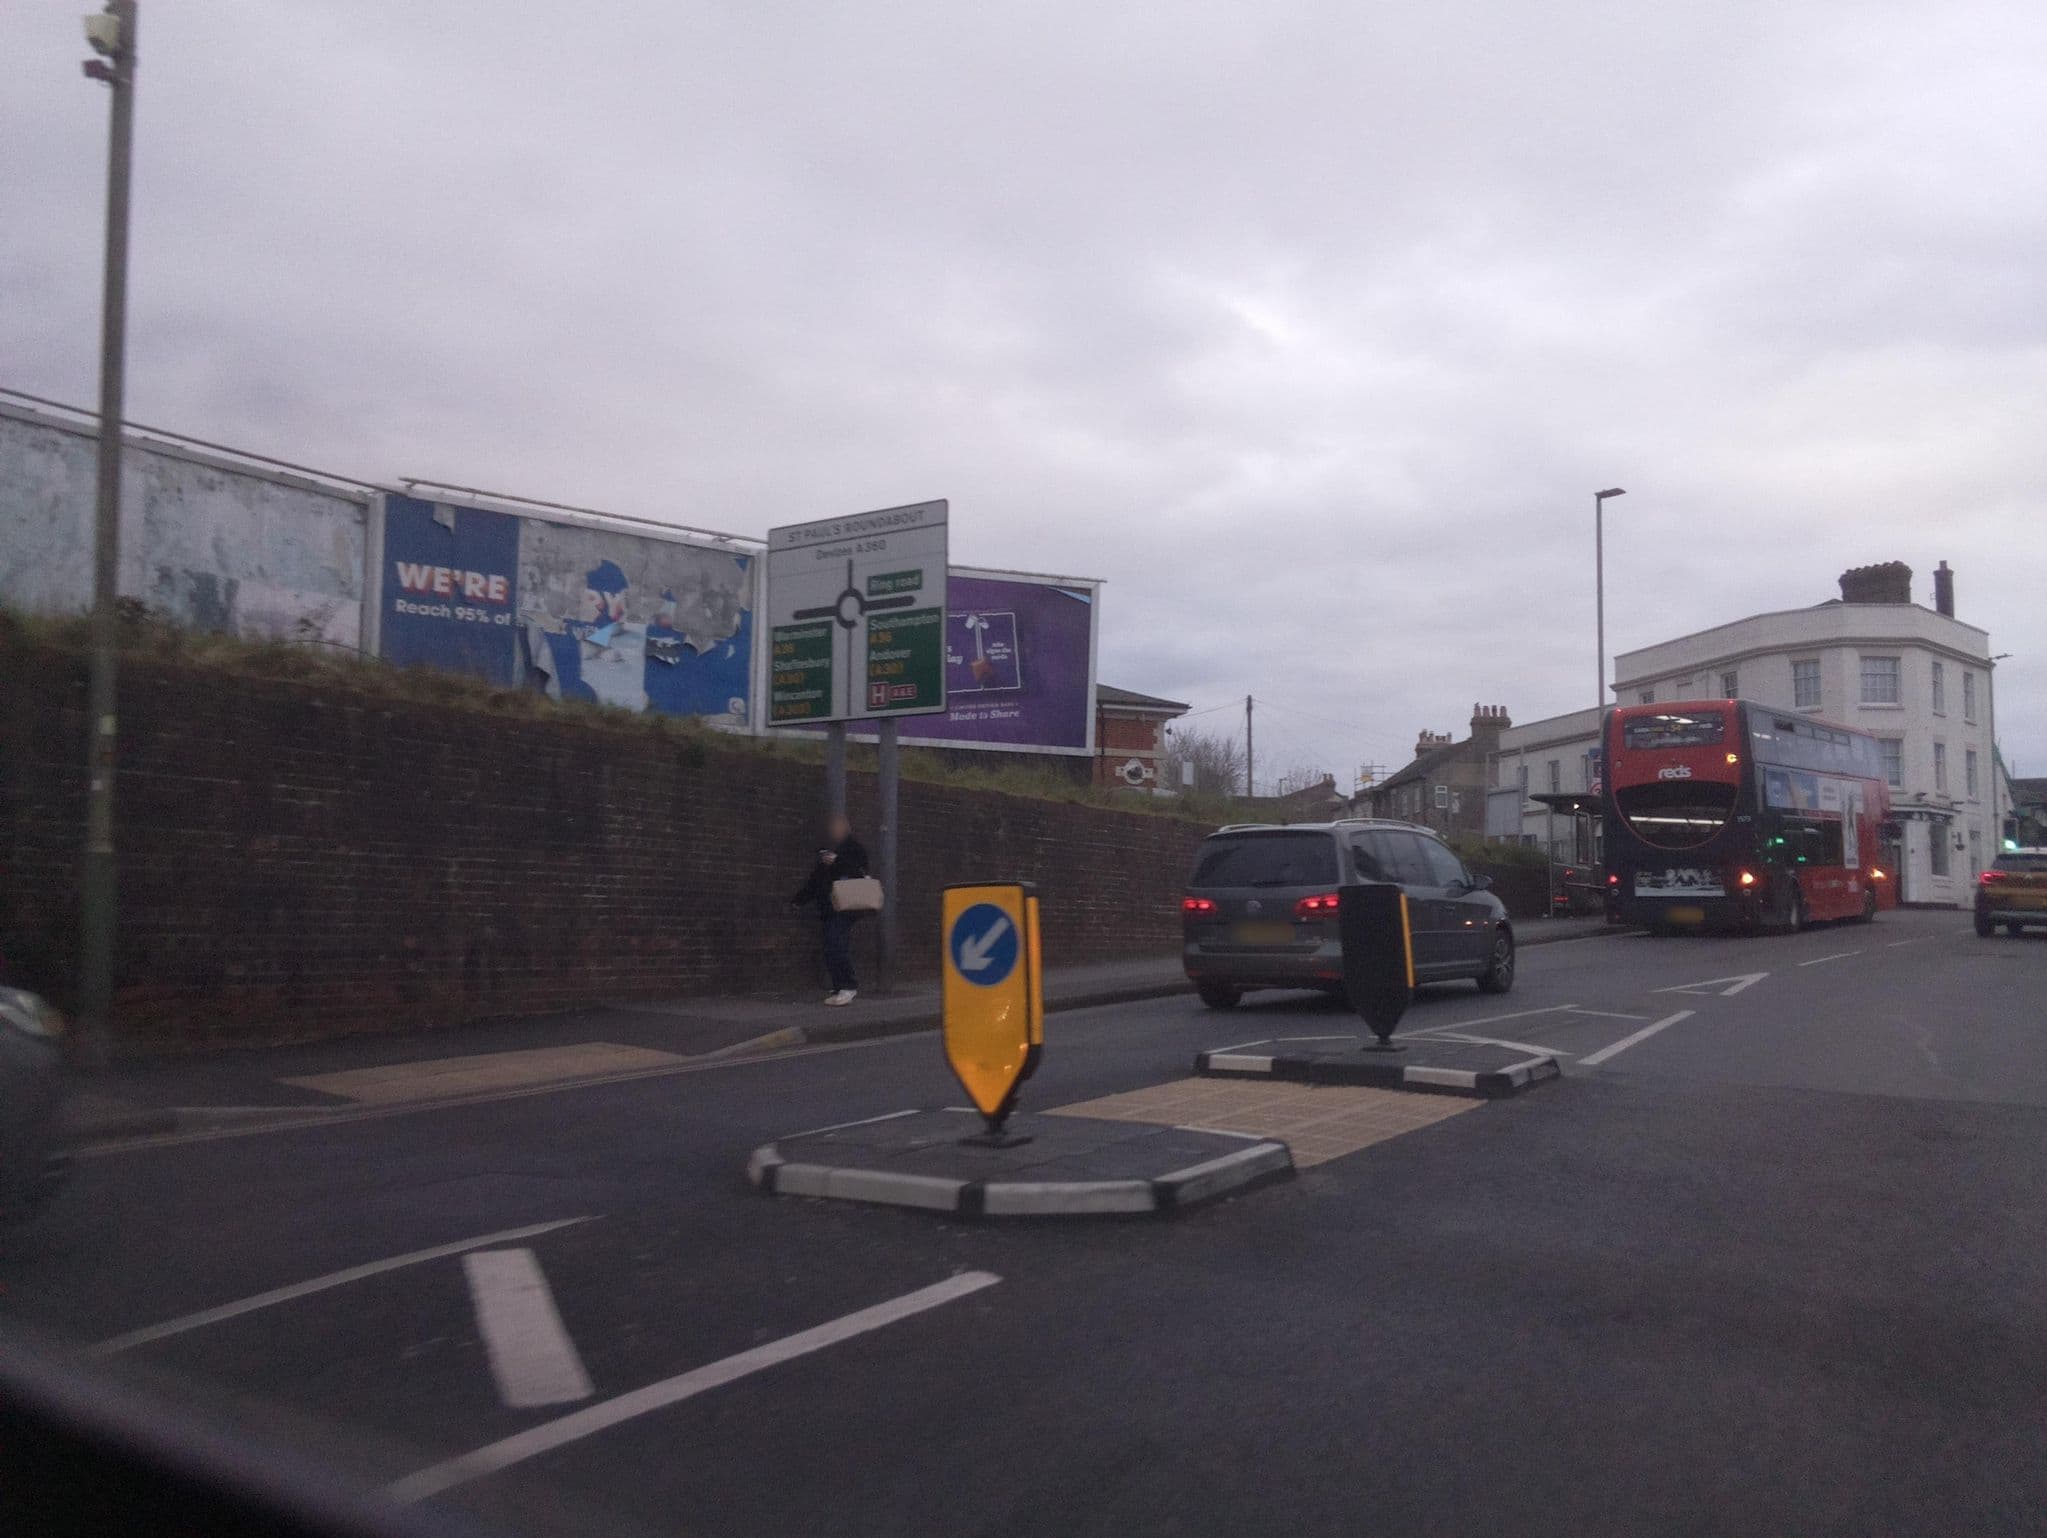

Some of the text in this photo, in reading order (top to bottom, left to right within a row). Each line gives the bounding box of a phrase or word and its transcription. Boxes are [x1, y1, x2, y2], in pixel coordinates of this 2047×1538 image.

[843, 509, 925, 533] ROUNDABOUT
[396, 561, 509, 604] WE'RE
[396, 598, 512, 626] Reach 95% of
[950, 709, 1020, 723] Made to Share
[1658, 765, 1693, 779] reds
